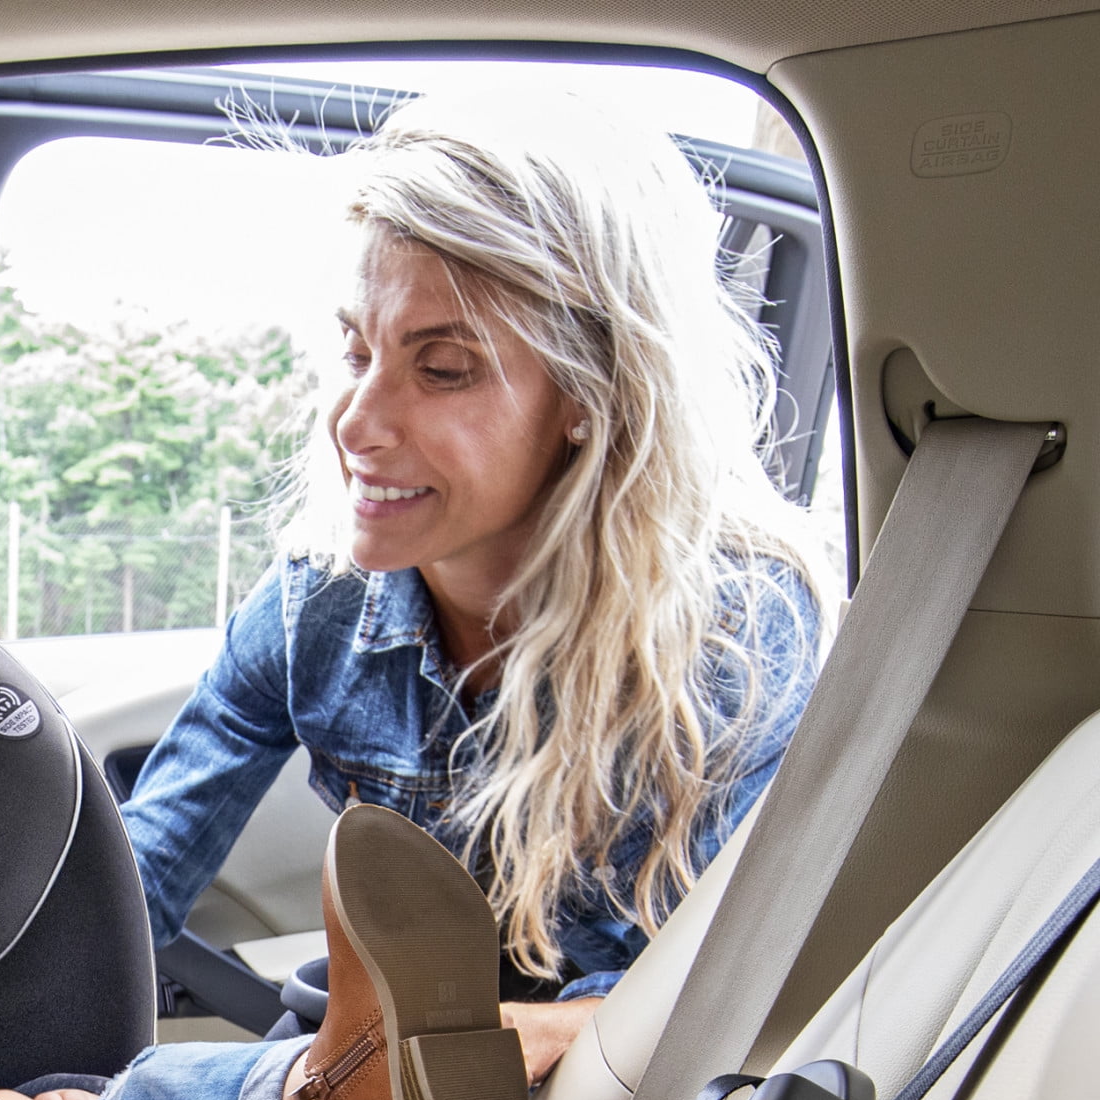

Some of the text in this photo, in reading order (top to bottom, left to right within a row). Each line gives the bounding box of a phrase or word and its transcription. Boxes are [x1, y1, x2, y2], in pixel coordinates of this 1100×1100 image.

[941, 120, 985, 137] SIDE
[923, 132, 1001, 152] CURTAIN
[919, 149, 1001, 169] AIRBAG
[12, 715, 36, 733] TESTED
